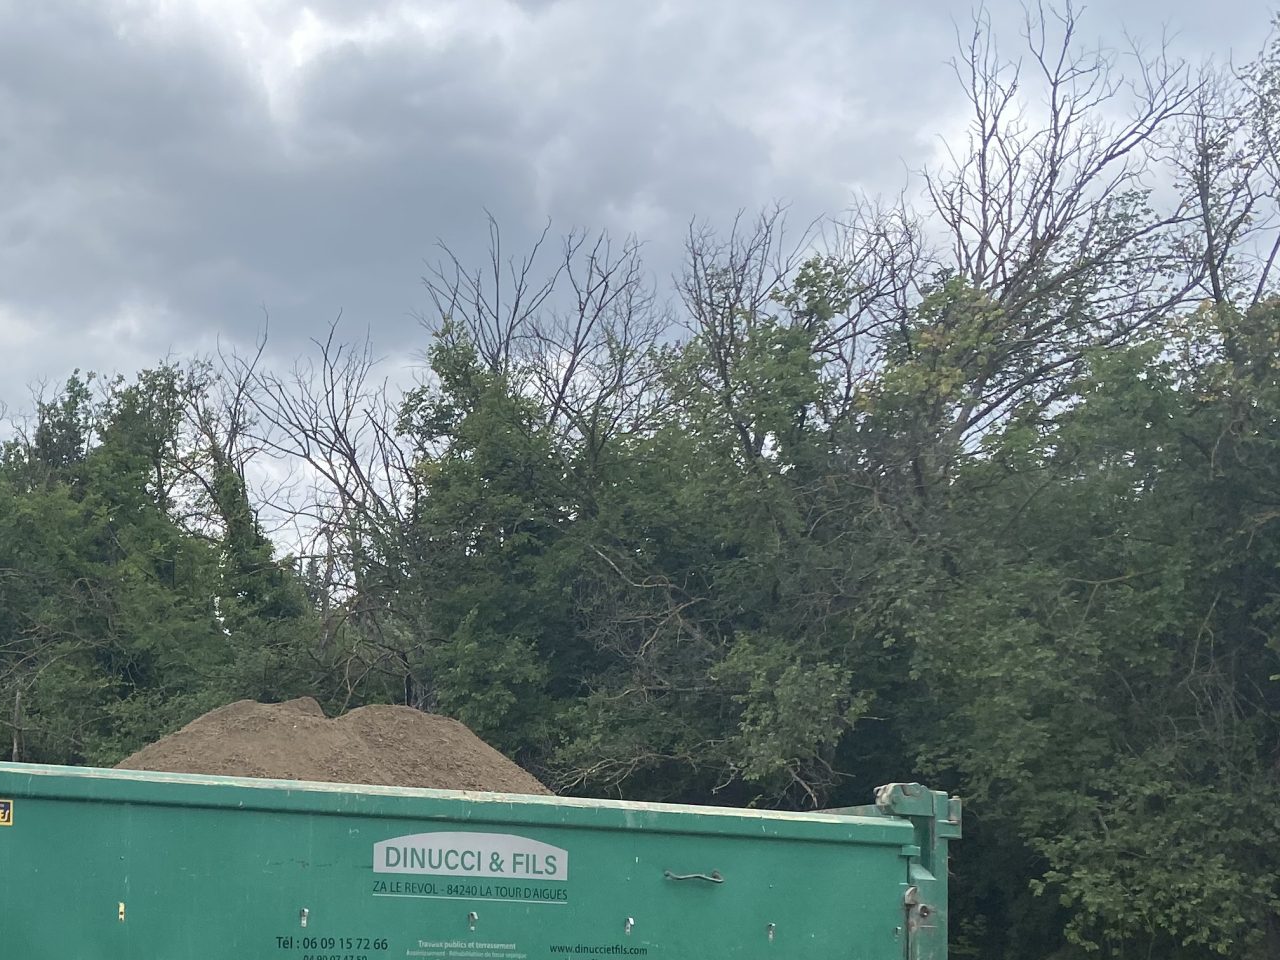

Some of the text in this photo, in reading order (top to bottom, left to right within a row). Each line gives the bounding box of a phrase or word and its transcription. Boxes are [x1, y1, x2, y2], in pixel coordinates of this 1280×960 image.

[385, 846, 557, 875] DINUCCI & FILS
[373, 881, 387, 893] ZA
[390, 882, 402, 893] LE
[404, 882, 438, 895] REVOL
[446, 885, 478, 897] 84240
[480, 886, 492, 897] LA
[494, 887, 521, 898] TOUR
[524, 888, 568, 901] D'AIGUES
[276, 936, 293, 949] Tél
[302, 937, 317, 949] 06
[320, 938, 335, 949] 09
[339, 938, 353, 949] 15
[356, 938, 370, 950] 72
[373, 939, 388, 950] 66
